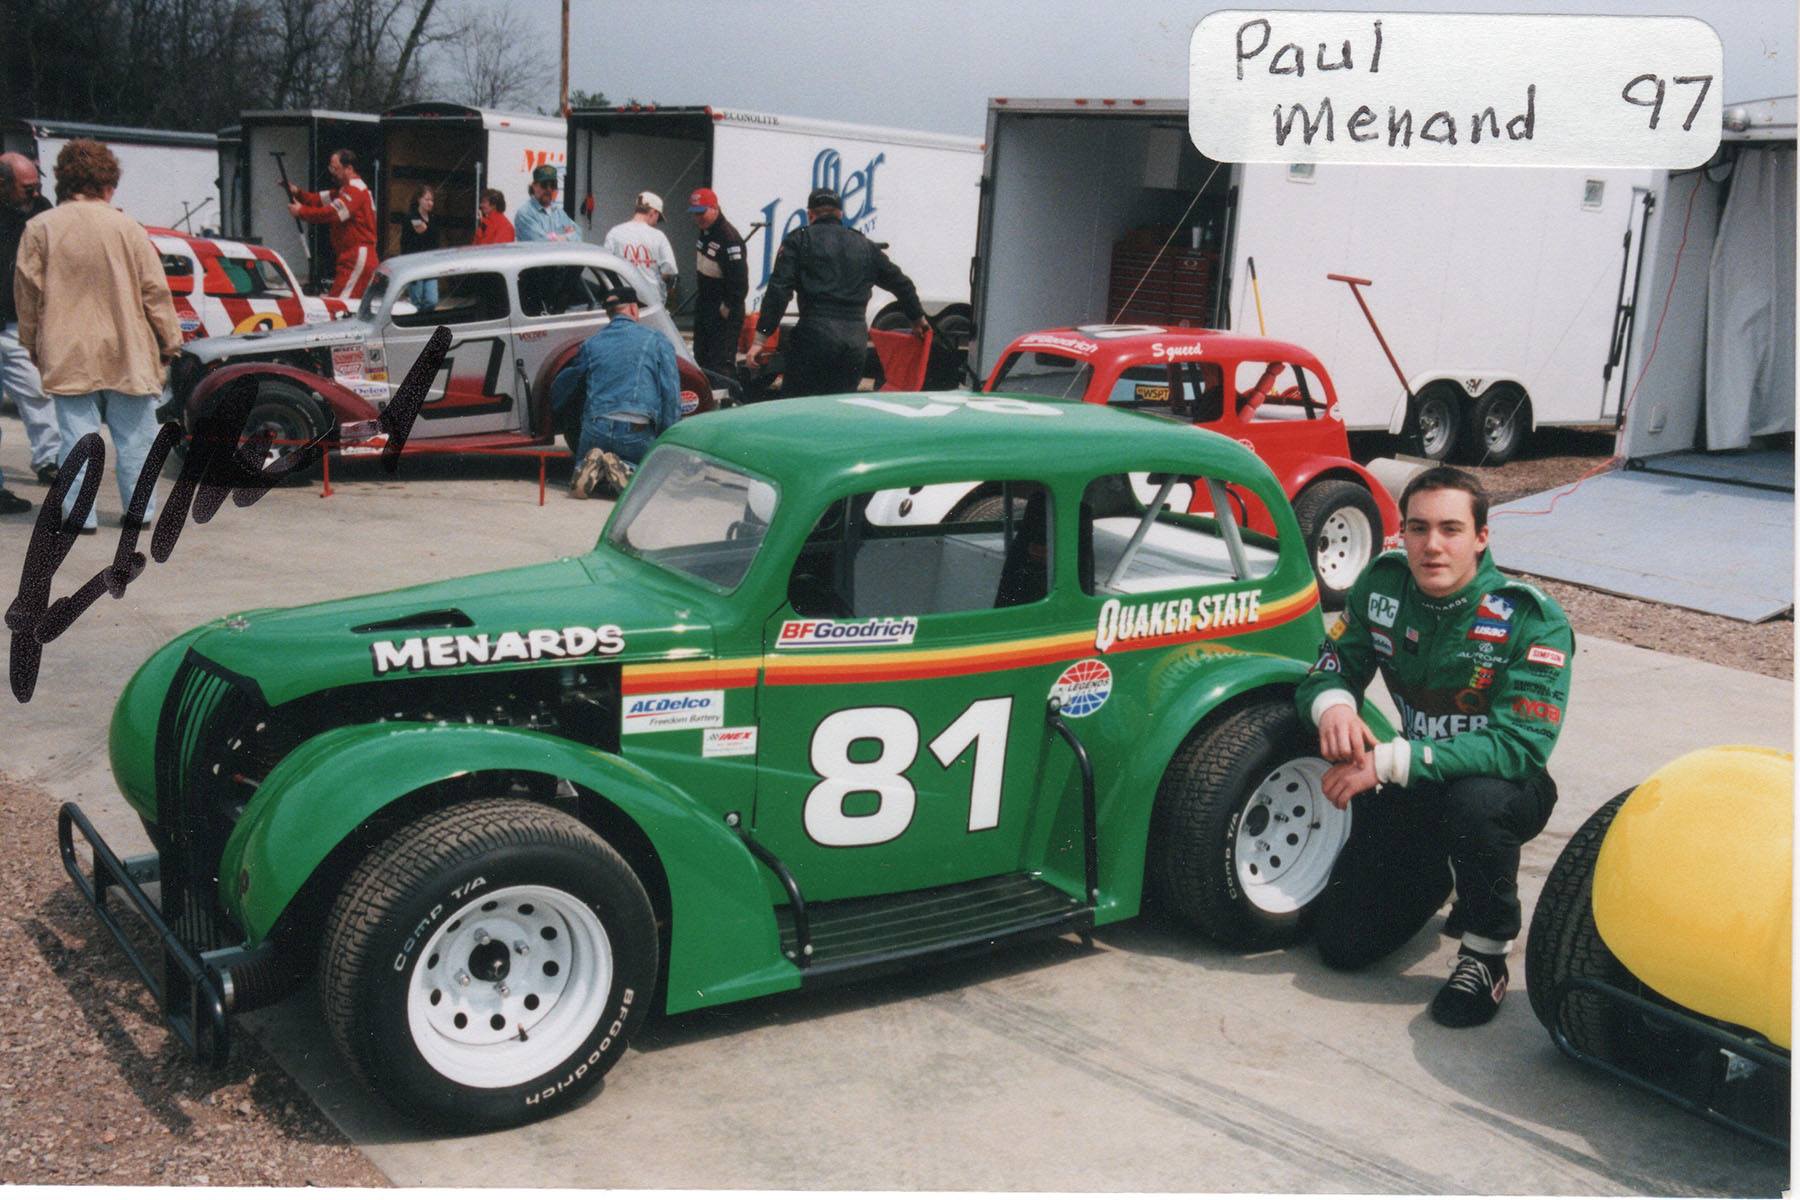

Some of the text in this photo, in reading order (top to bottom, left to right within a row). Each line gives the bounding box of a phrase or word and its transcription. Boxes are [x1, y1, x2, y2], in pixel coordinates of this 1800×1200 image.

[1236, 18, 1383, 80] Paul
[1620, 73, 1714, 131] 97
[780, 619, 917, 641] BFGoodrich
[1095, 589, 1263, 653] QUAKER STATE
[372, 624, 626, 676] MENARDS
[629, 696, 711, 714] ACDelco
[802, 694, 1015, 849] 81
[451, 876, 487, 900] T/A
